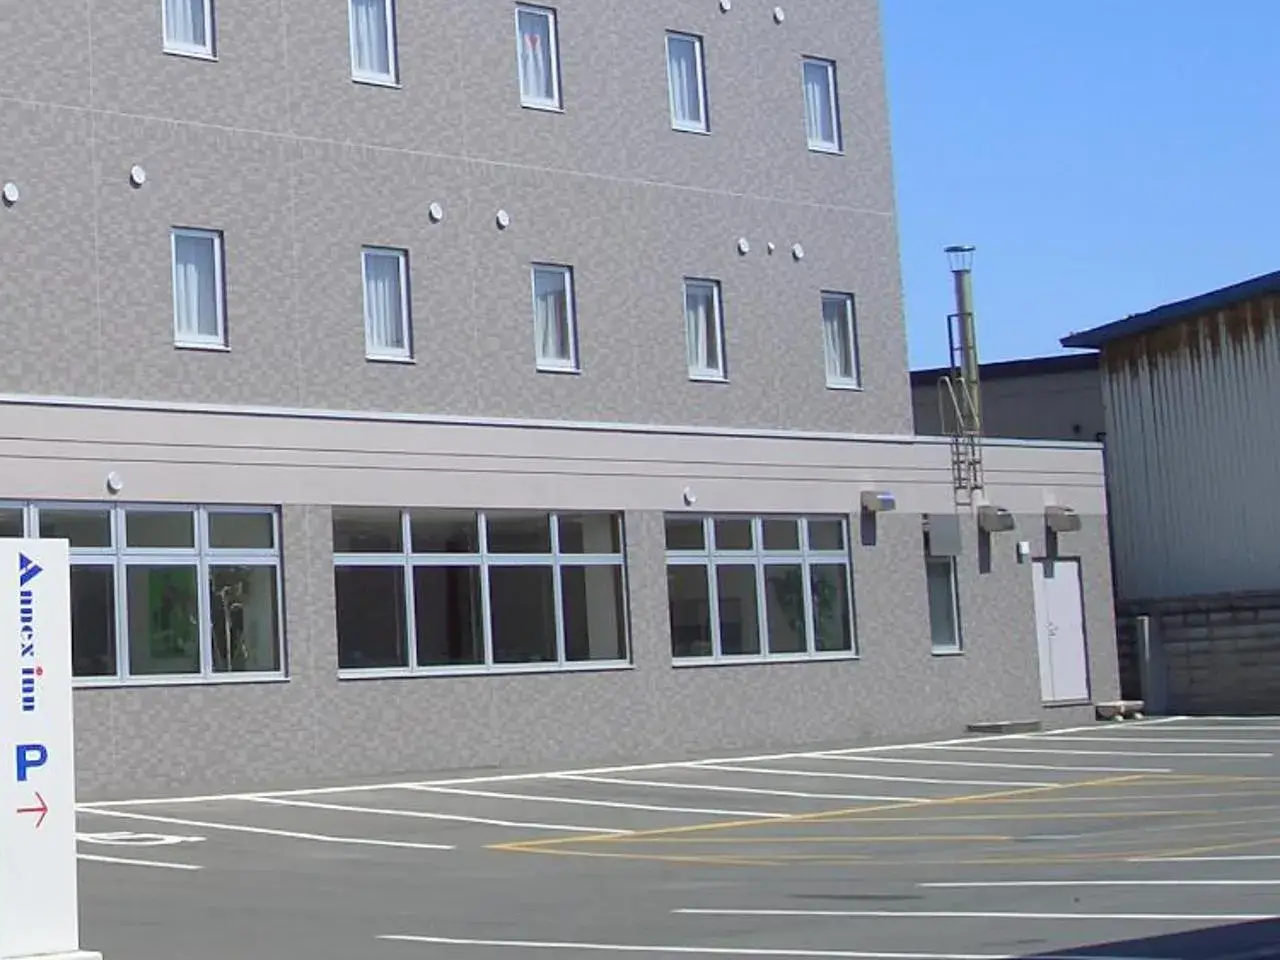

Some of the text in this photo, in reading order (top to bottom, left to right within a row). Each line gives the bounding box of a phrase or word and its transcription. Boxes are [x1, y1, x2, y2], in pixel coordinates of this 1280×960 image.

[19, 552, 44, 711] Annex inn
[16, 744, 48, 781] P
